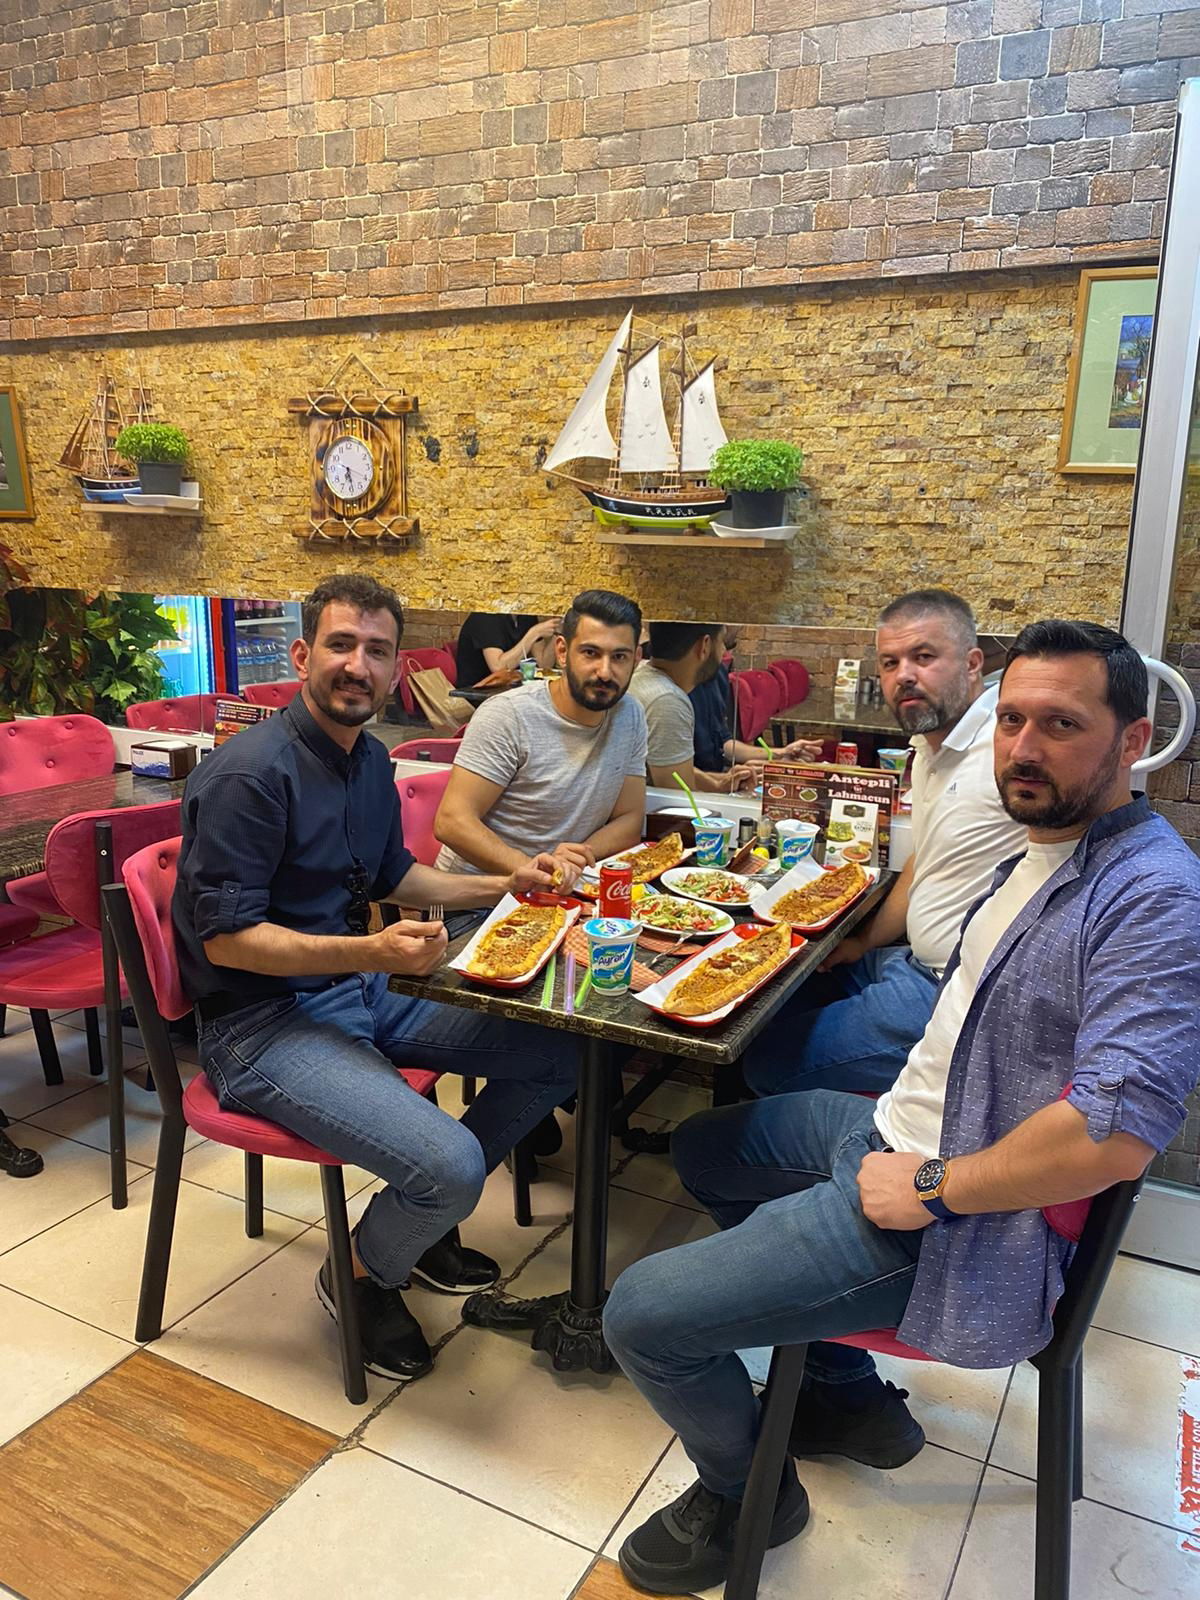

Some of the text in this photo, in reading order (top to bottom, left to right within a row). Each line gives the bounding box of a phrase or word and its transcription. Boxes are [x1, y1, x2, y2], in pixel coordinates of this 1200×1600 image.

[365, 463, 371, 471] 3
[340, 483, 345, 491] 7
[357, 481, 363, 489] 5
[828, 773, 891, 788] Antepli
[828, 789, 891, 805] Lahmacun
[598, 952, 626, 966] Ayran
